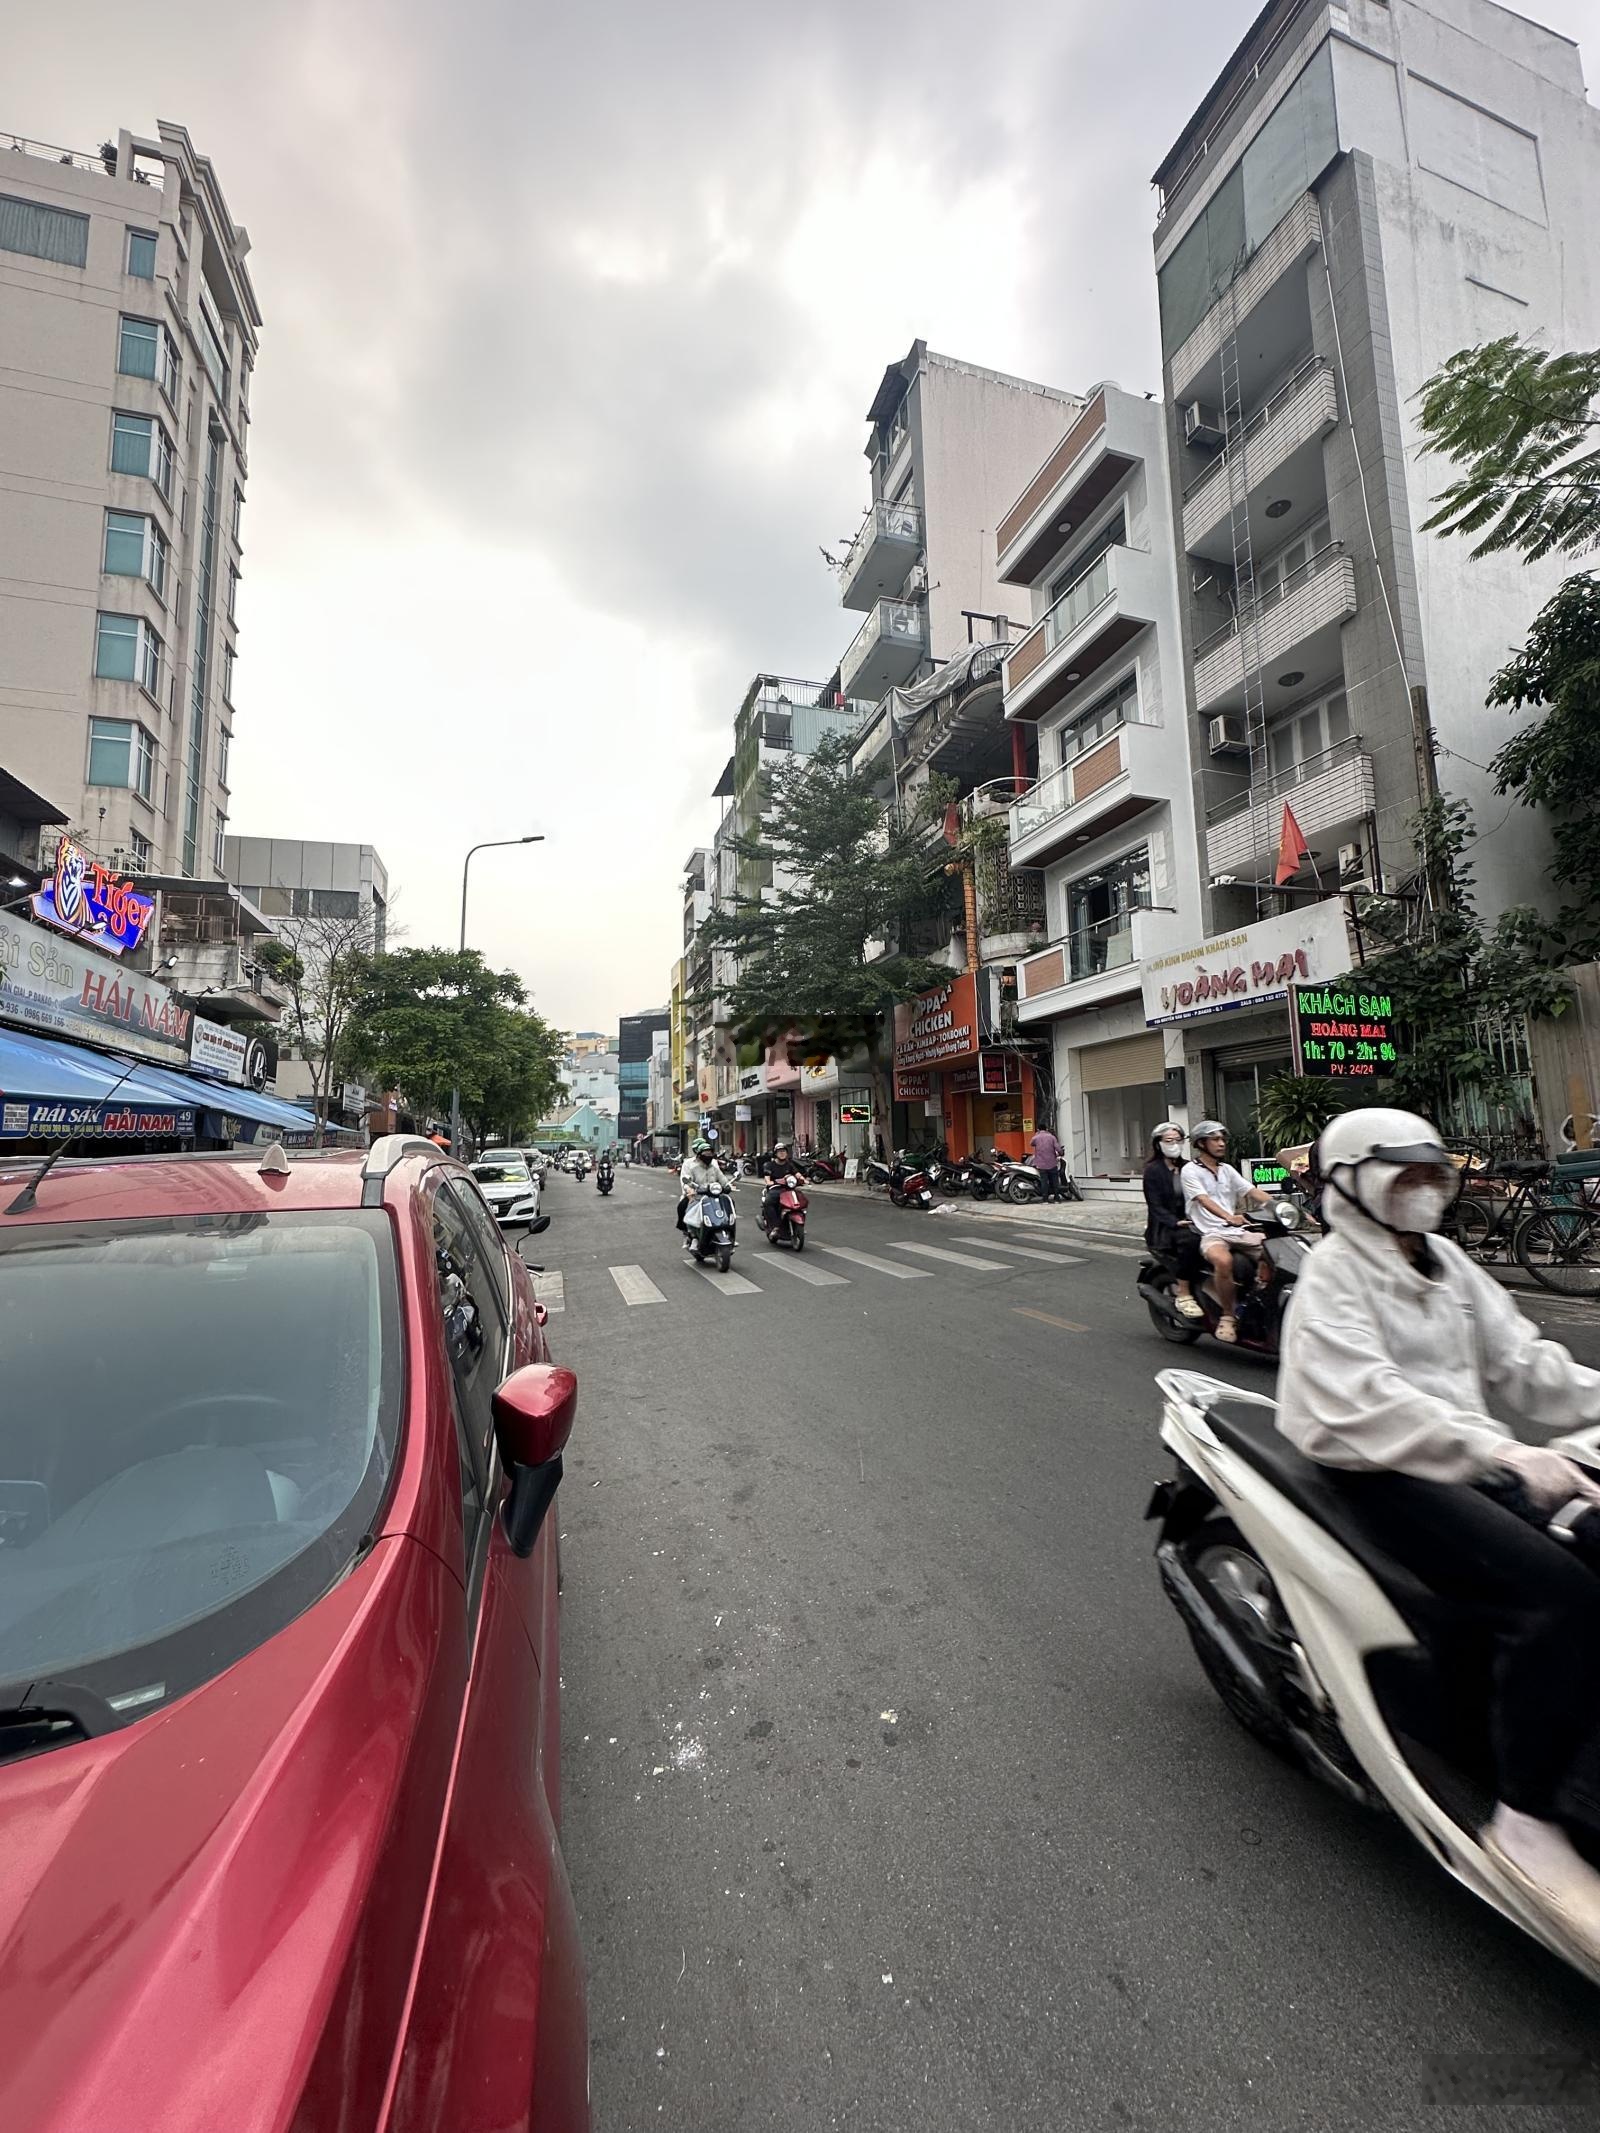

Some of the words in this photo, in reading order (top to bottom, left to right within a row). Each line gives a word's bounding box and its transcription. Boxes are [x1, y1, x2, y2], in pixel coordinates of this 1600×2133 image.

[91, 862, 150, 937] Tiger
[1182, 949, 1204, 963] DOANH
[1205, 939, 1231, 956] KHÁCH
[1231, 933, 1248, 949] SẠN
[28, 941, 74, 988] Sản
[1251, 948, 1309, 988] MAI
[79, 968, 135, 1022] HẢI
[138, 993, 191, 1041] NAM
[1299, 988, 1356, 1016] KHÁCH
[1359, 995, 1392, 1020] SẠN
[910, 1010, 952, 1038] CHICKEN
[1310, 1020, 1358, 1037] HOÀNG
[1360, 1024, 1387, 1038] MAI
[1303, 1041, 1326, 1059] 1h:
[1328, 1041, 1345, 1060] 70
[1356, 1042, 1378, 1060] 2h:
[1330, 1063, 1347, 1075] PV:
[1349, 1064, 1374, 1075] 24/24
[899, 1087, 930, 1096] CHICKEN
[103, 1107, 137, 1132] HẢI
[138, 1113, 176, 1132] NAM
[179, 1111, 191, 1121] 49
